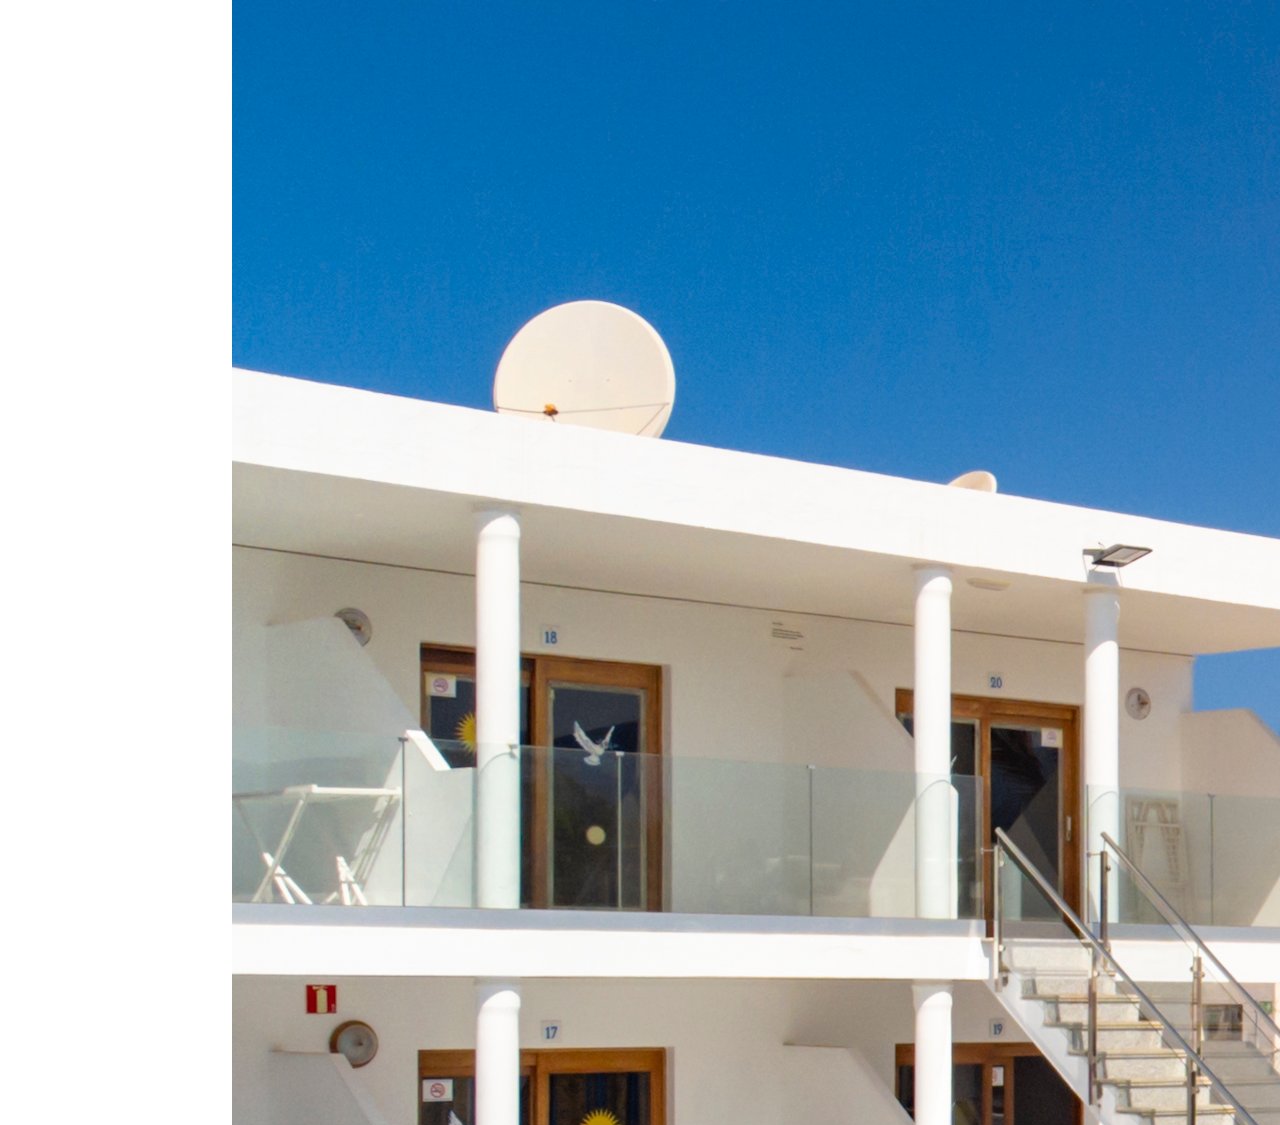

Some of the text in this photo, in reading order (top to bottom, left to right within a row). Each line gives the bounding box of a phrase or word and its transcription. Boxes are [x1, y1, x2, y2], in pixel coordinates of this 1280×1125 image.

[545, 631, 558, 644] 18
[990, 676, 1002, 688] 20
[545, 1026, 558, 1039] 17
[993, 1023, 1003, 1035] 19
